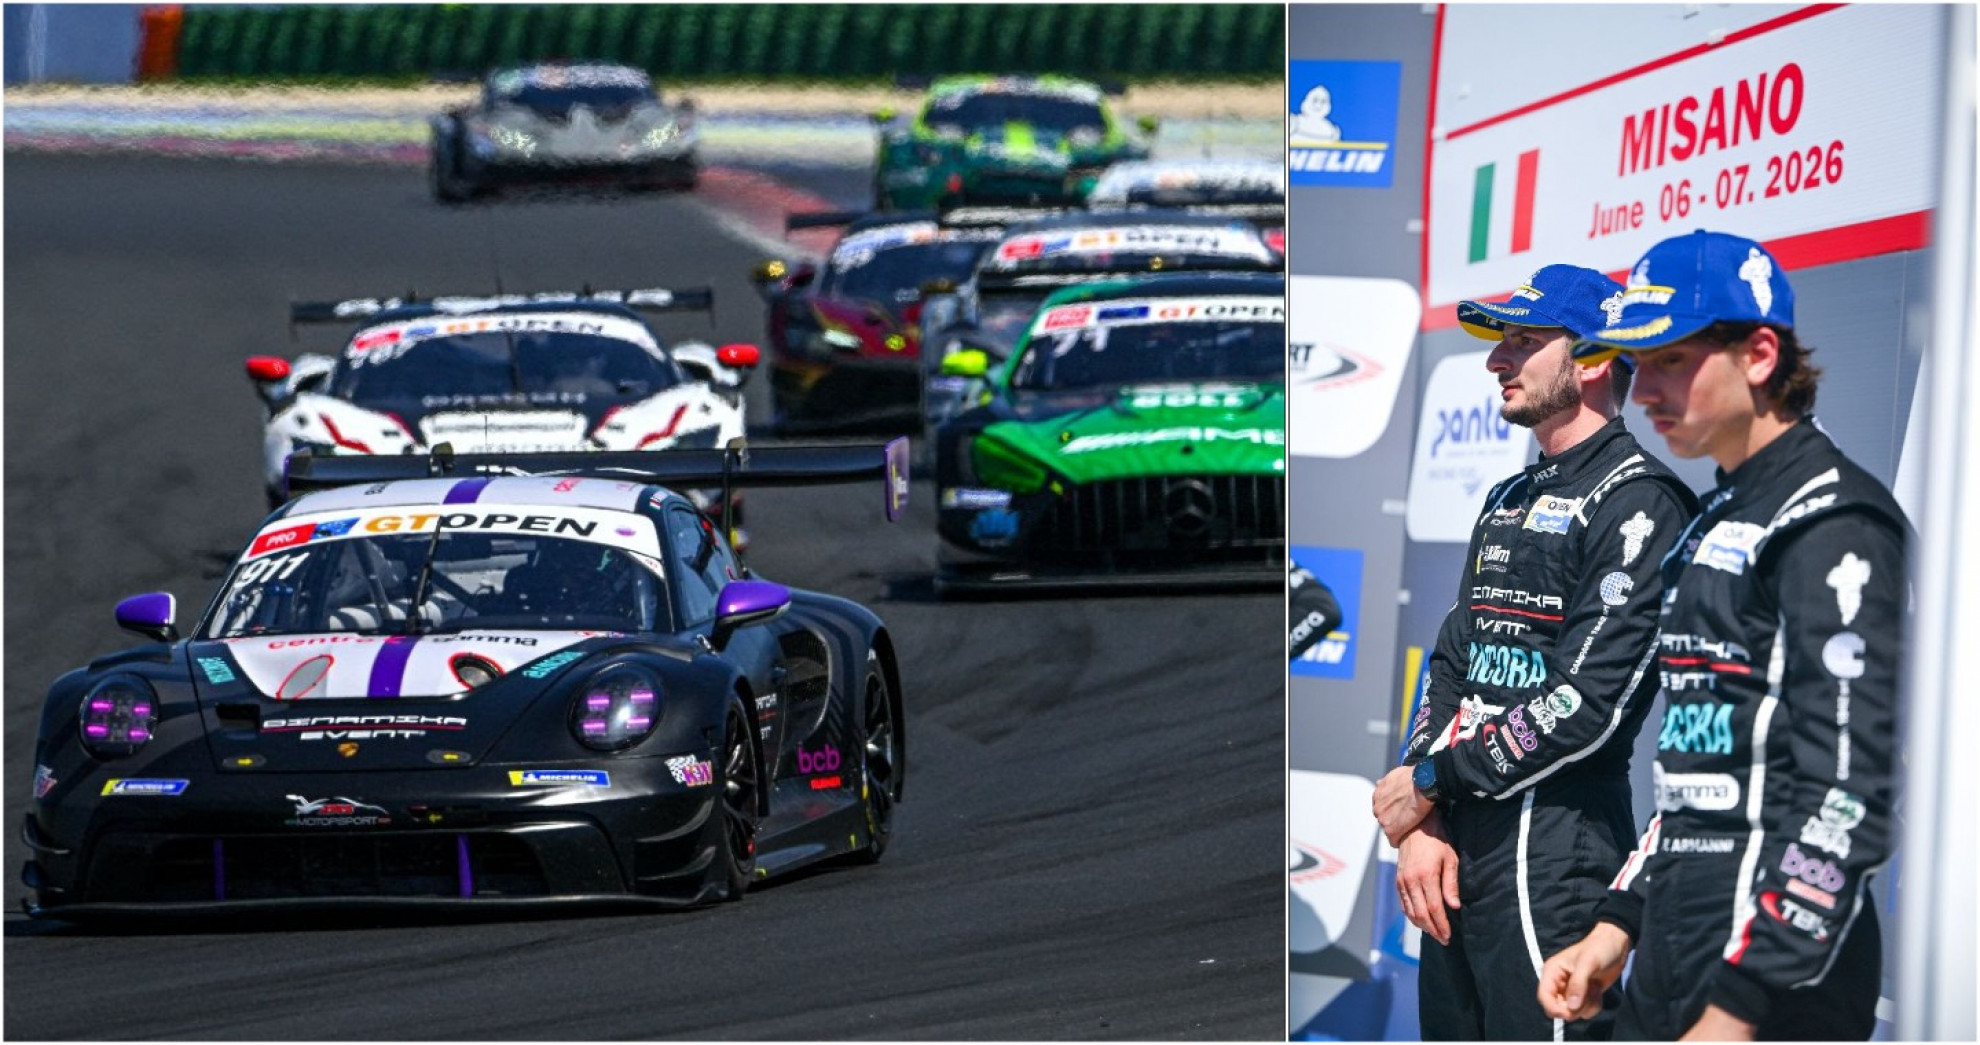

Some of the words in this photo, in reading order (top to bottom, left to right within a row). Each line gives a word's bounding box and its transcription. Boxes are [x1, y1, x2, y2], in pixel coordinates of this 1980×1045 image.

[1618, 62, 1804, 178] MISANO
[1587, 202, 1644, 240] June
[1659, 179, 1692, 222] 06
[1715, 164, 1755, 209] 07.
[1764, 140, 1845, 199] 2026
[265, 531, 298, 547] PRO
[233, 551, 311, 589] 911
[1507, 703, 1539, 752] bcb
[538, 773, 599, 783] MICHELIN
[798, 742, 841, 774] bcb
[1779, 842, 1846, 893] bcb
